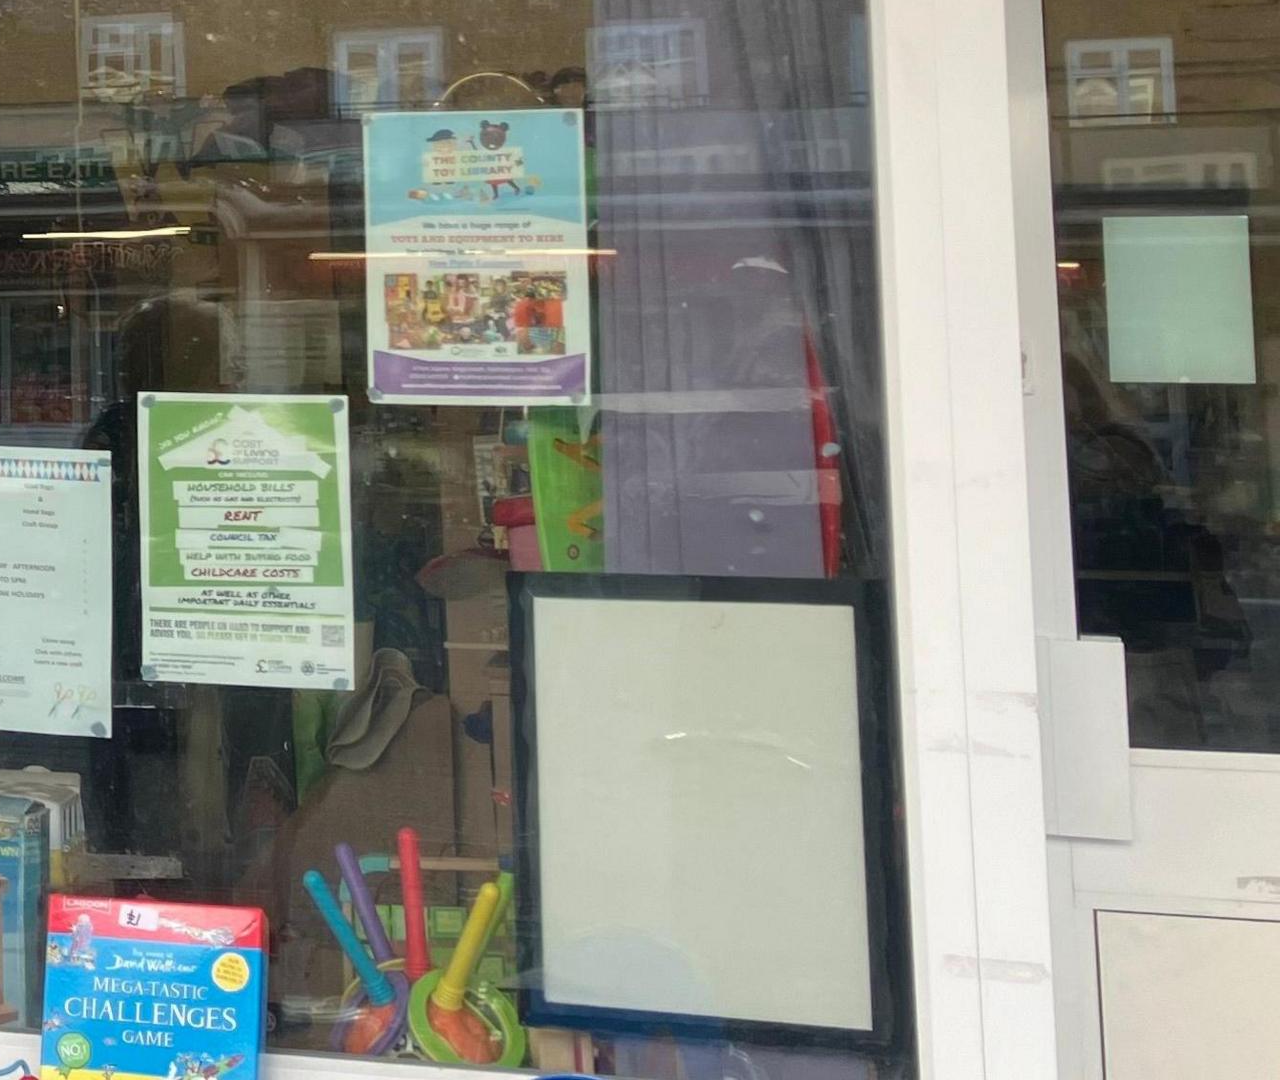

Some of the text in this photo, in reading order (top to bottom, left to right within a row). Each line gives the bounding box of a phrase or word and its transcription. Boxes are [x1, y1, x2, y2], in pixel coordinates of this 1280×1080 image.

[432, 152, 512, 165] THE COUNTY
[47, 160, 105, 179] EXIT
[432, 166, 513, 177] TOY LIBRARY
[421, 235, 446, 243] AND
[448, 235, 514, 244] EQUIPMENT
[232, 439, 263, 449] COST
[187, 482, 296, 493] HOUSEHOLD BILLS
[224, 510, 263, 522] RENT
[210, 533, 278, 542] COUNCIL TAX
[186, 552, 212, 561] HELP
[215, 552, 243, 561] WITH
[285, 553, 312, 562] FOOD
[12, 562, 56, 572] AFTERNOON
[191, 567, 301, 579] CHILDCARE COSTS
[216, 590, 241, 599] WELL
[178, 596, 232, 606] IMPORTANT
[106, 954, 146, 971] David
[93, 975, 209, 1001] MEGA-TASTIC
[64, 996, 237, 1032] CHALLENGES
[122, 1028, 175, 1048] GAME
